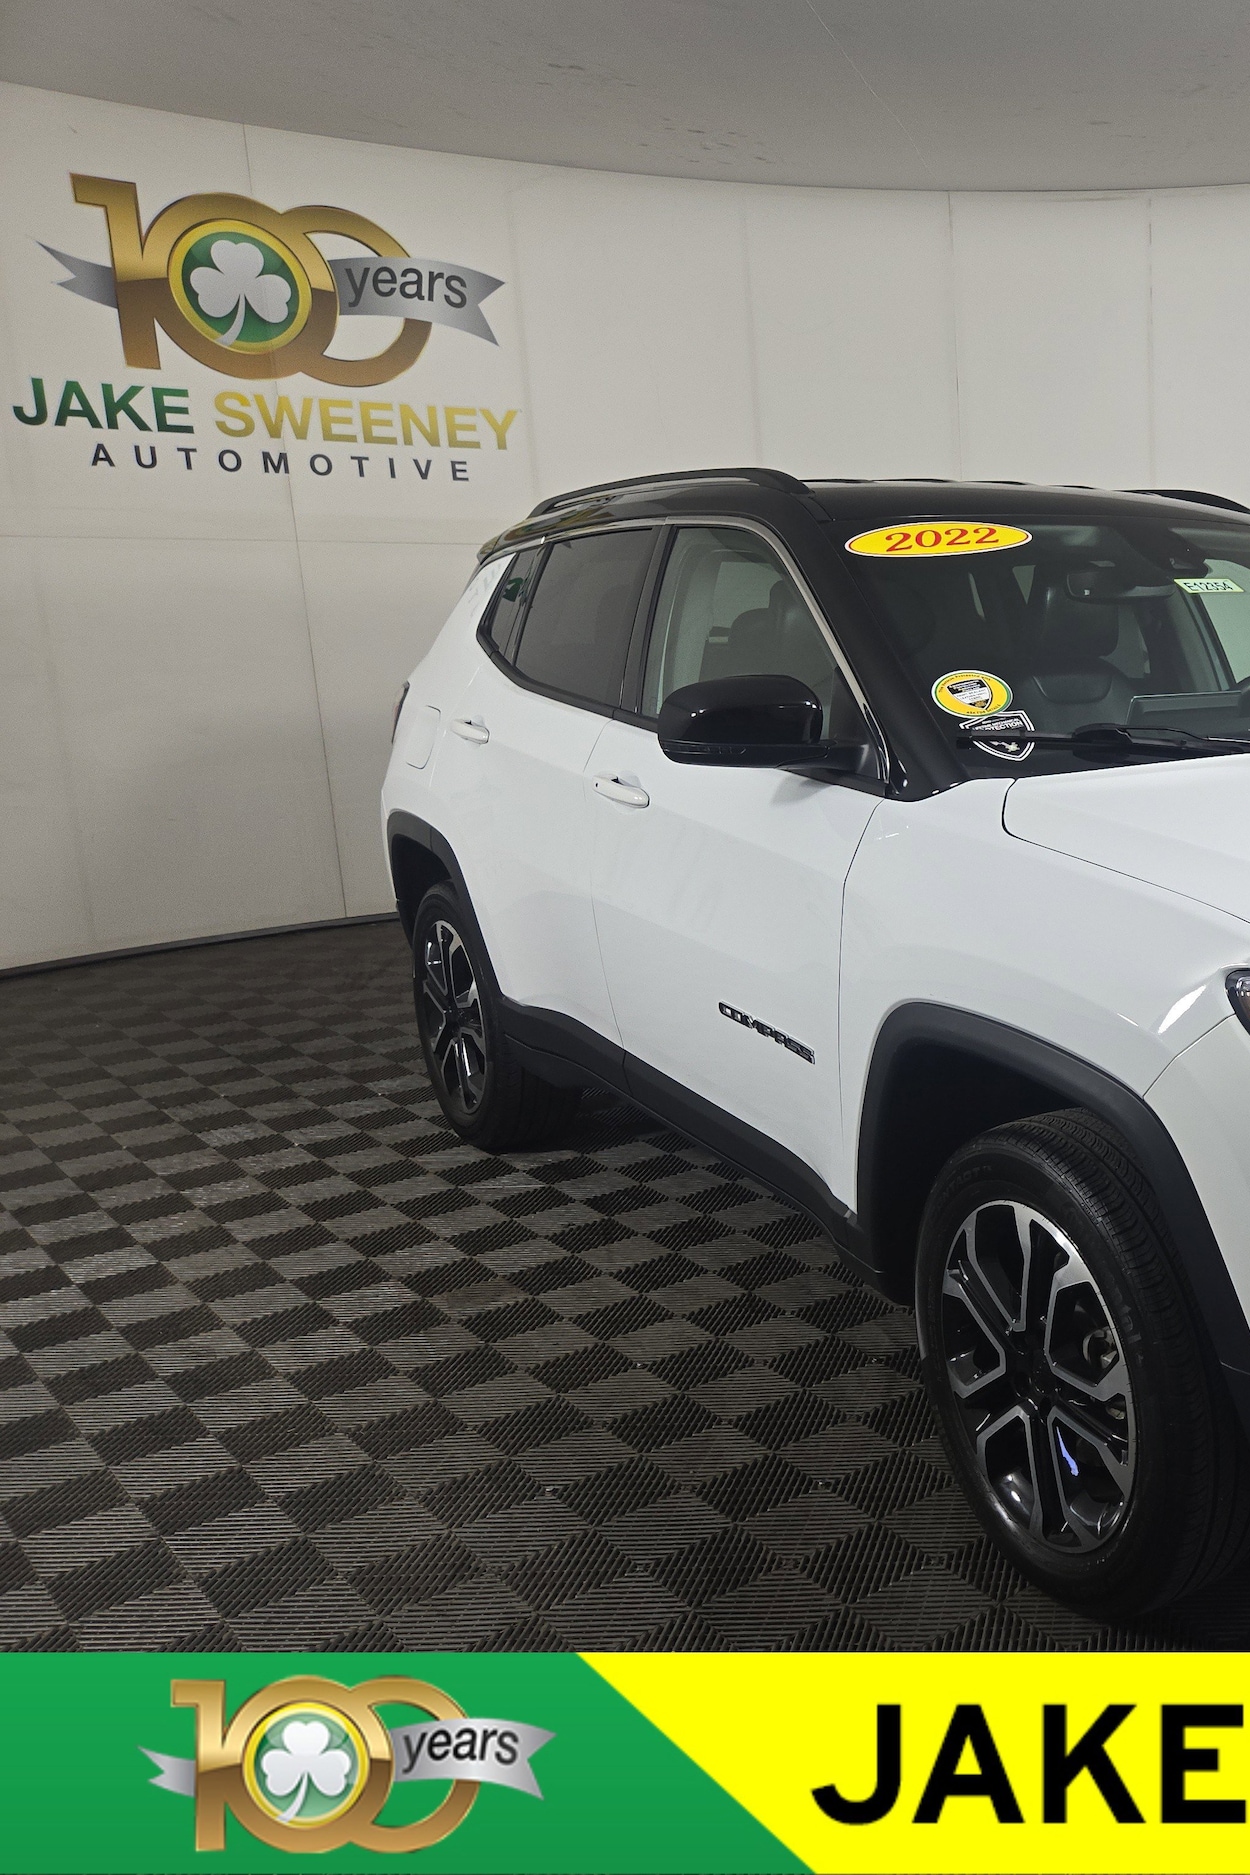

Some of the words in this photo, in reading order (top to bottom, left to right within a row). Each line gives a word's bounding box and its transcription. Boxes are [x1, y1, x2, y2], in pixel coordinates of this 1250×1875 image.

[70, 172, 432, 388] 100
[345, 264, 468, 309] years
[13, 377, 195, 434] JAKE
[214, 391, 517, 451] SWEENEY
[91, 443, 470, 482] AUTOMOTIVE
[885, 527, 999, 552] 2022
[718, 1001, 816, 1065] COMPASS
